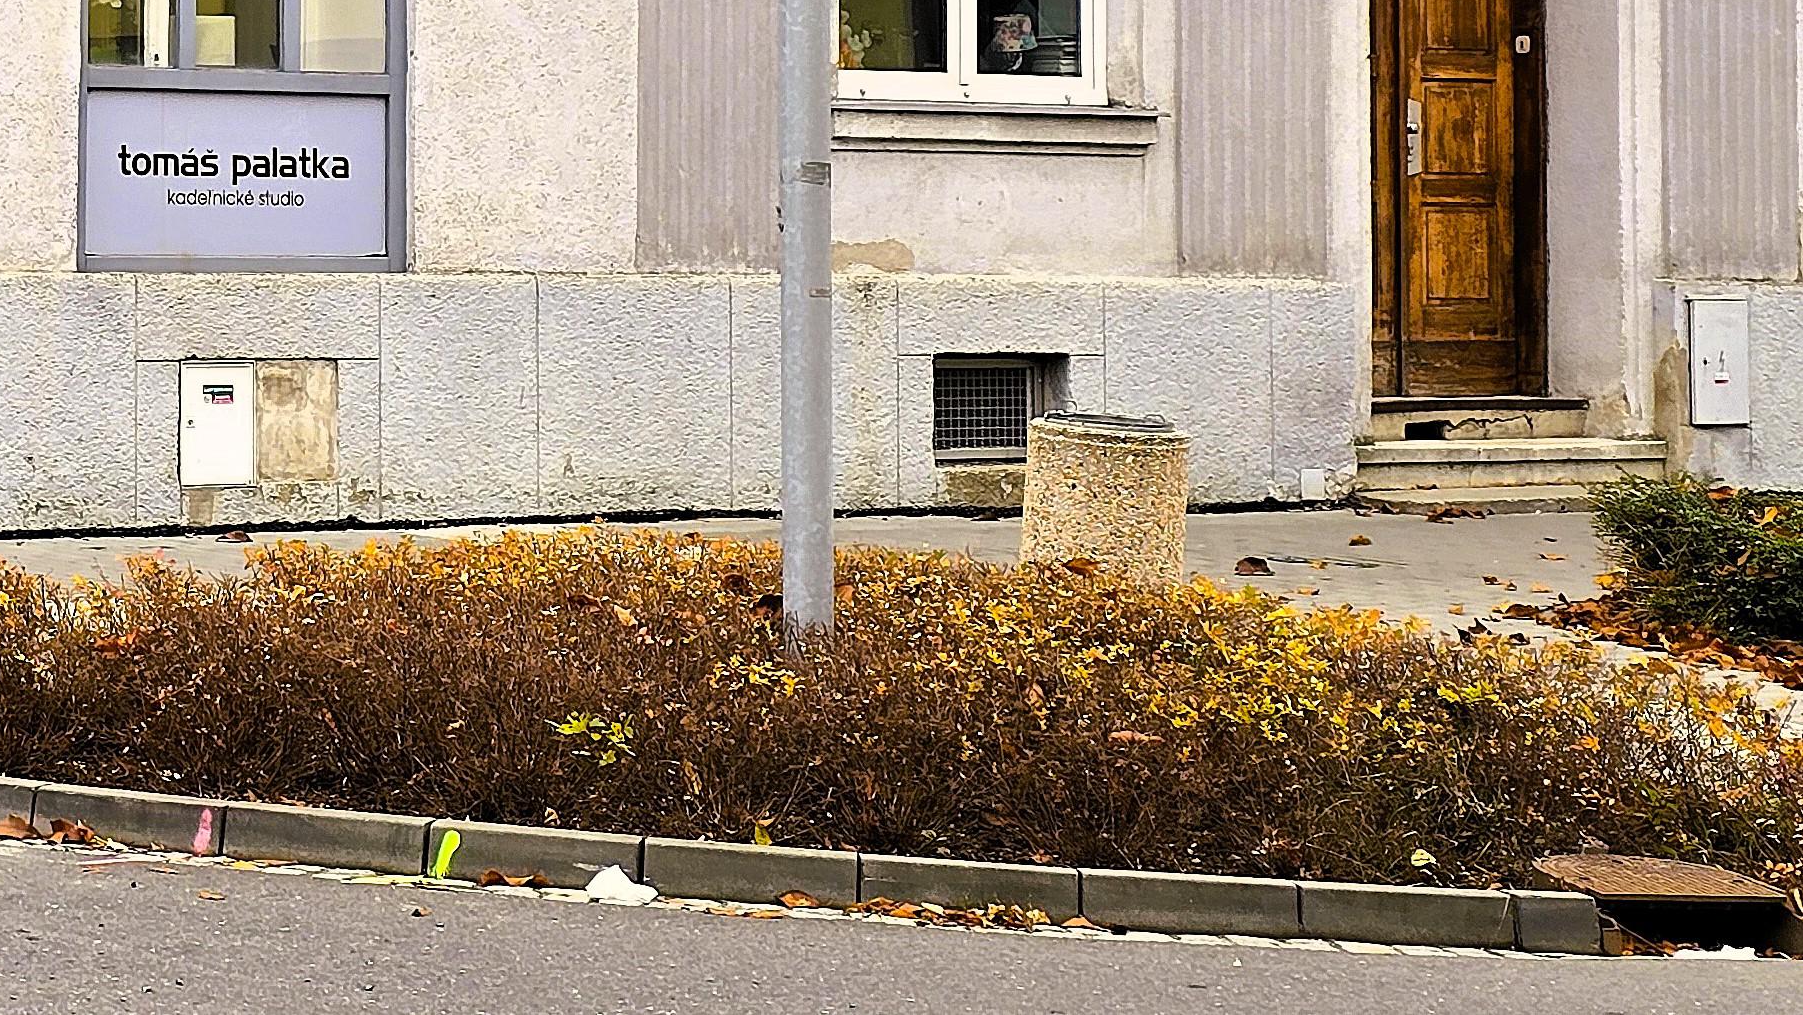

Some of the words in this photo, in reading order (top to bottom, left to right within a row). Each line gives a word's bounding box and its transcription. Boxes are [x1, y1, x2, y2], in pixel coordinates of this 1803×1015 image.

[117, 144, 219, 177] tomáš
[231, 146, 350, 185] palatka
[258, 189, 305, 207] studio
